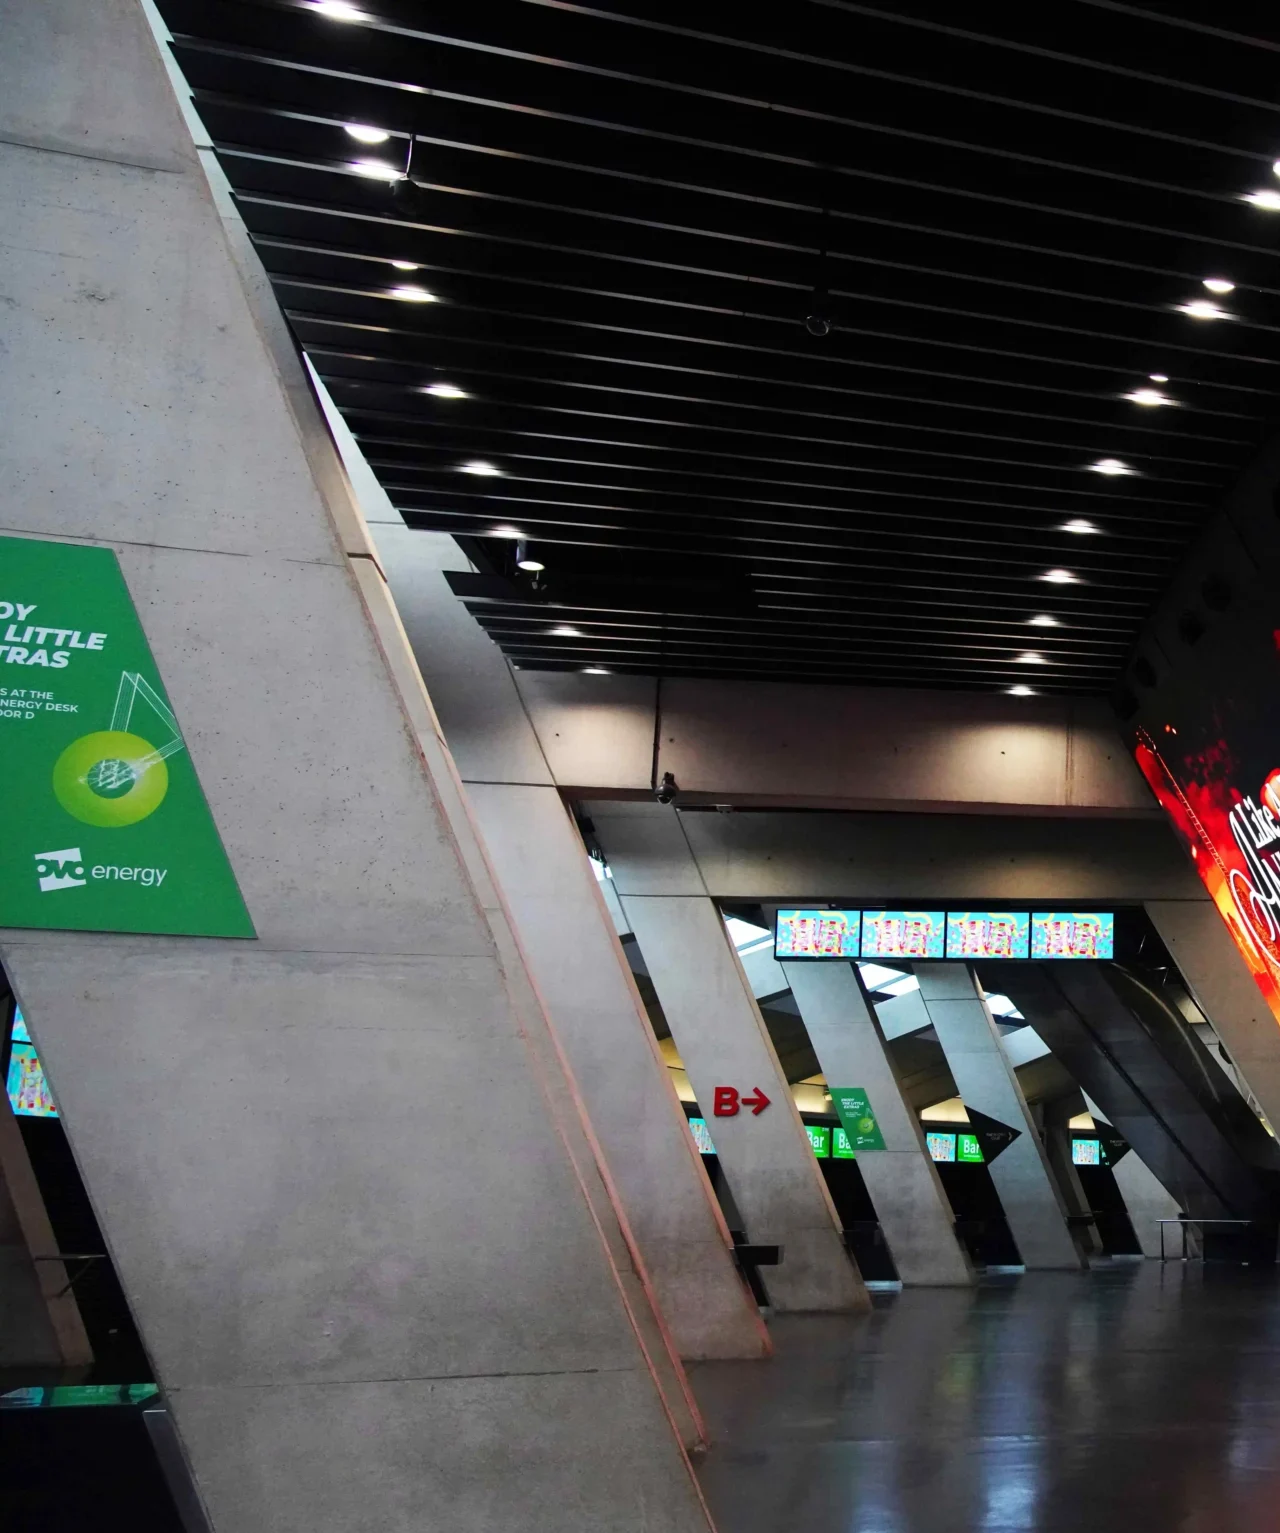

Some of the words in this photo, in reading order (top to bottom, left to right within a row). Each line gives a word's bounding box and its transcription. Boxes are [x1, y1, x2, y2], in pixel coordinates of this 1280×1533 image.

[4, 624, 108, 651] LITTLE
[10, 689, 27, 698] AT
[30, 690, 54, 700] THE
[0, 709, 21, 719] OR
[25, 711, 35, 720] D
[45, 703, 79, 713] DESK
[91, 865, 167, 887] energy
[713, 1086, 740, 1117] B
[839, 1133, 852, 1149] Ba
[963, 1139, 980, 1154] Bar
